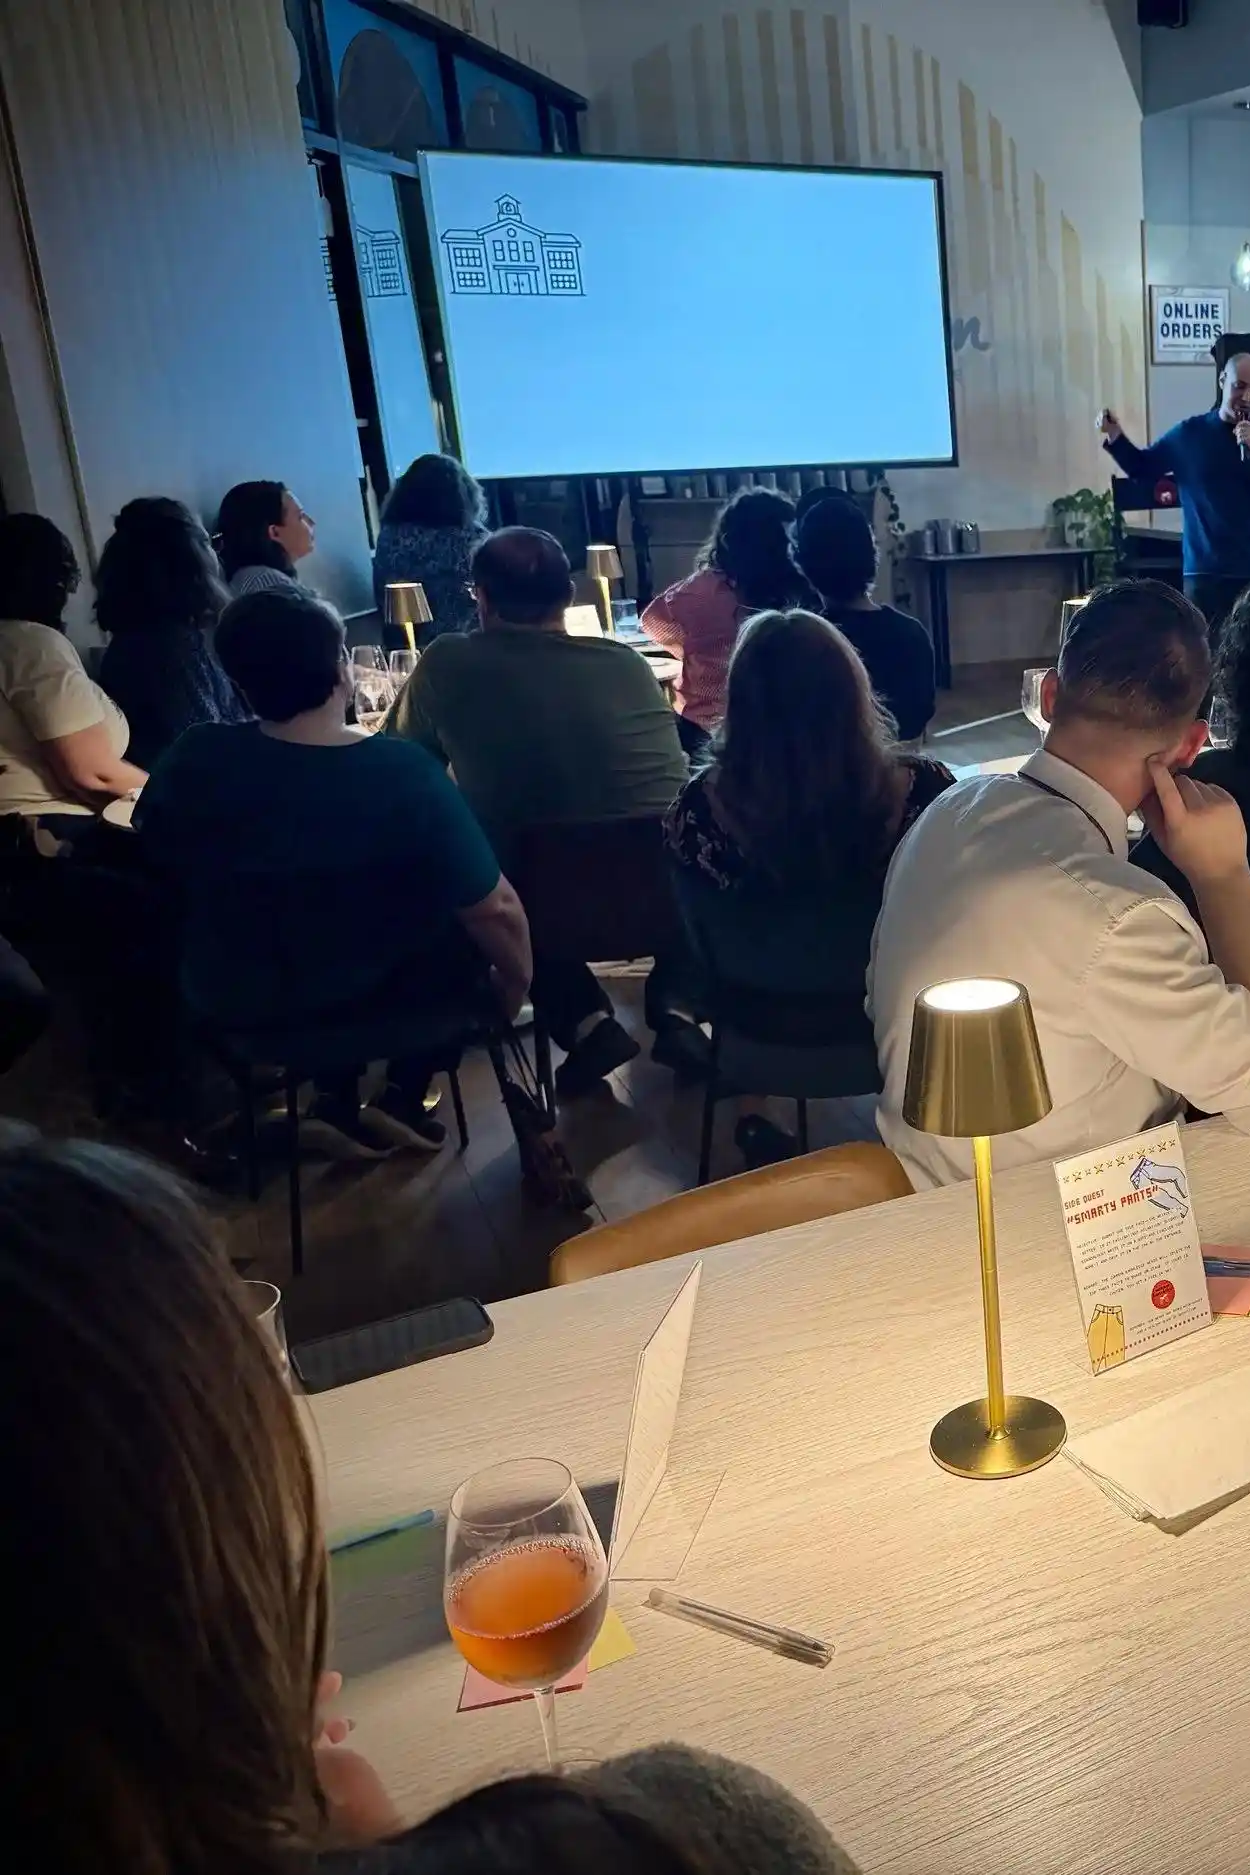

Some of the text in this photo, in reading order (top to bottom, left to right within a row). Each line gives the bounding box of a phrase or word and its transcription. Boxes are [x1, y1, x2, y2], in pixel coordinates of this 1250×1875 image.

[1163, 302, 1220, 319] ONLINE
[1160, 322, 1223, 339] ORDERS
[1064, 1188, 1105, 1210] SIDE QUEST
